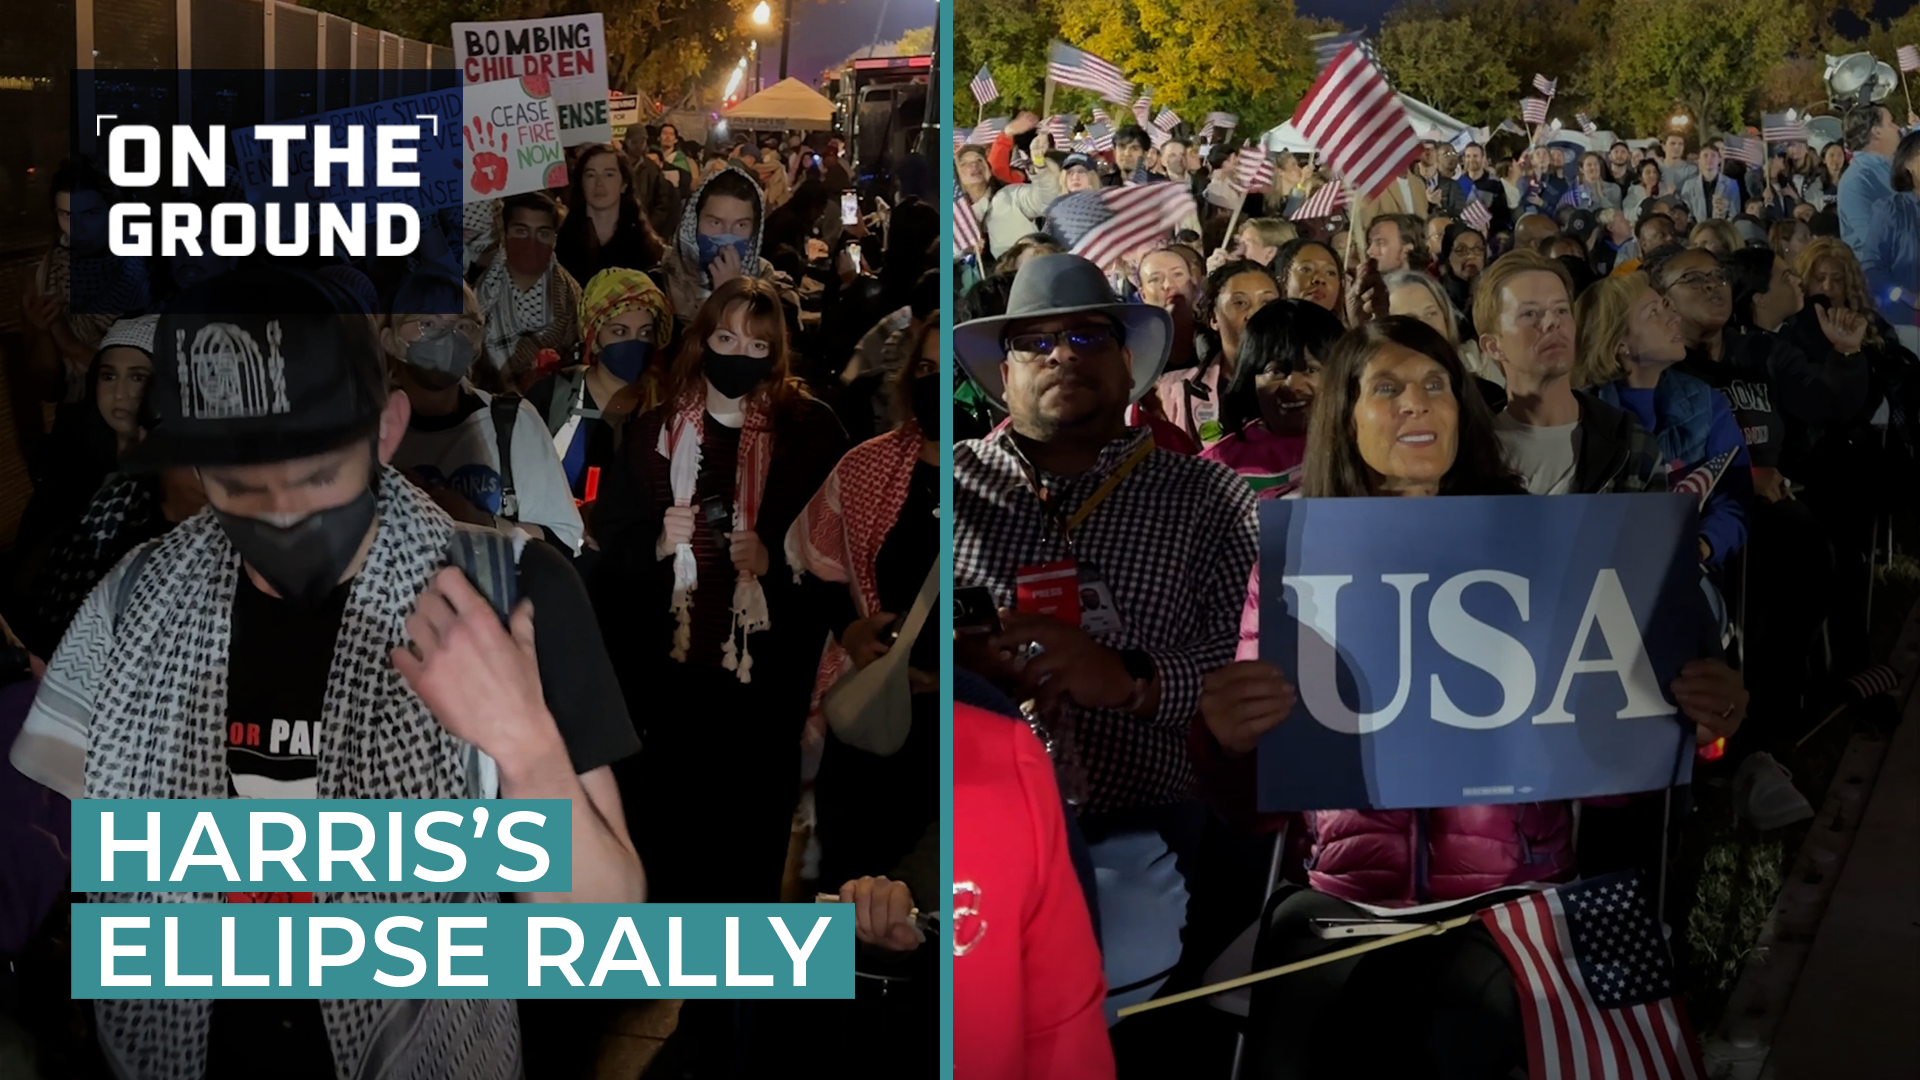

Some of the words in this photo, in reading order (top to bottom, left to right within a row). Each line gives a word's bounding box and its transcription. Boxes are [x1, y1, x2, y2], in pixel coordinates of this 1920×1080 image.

[464, 23, 591, 57] BOMBING
[464, 49, 595, 83] CHILDREN
[392, 93, 462, 128] STUPID
[491, 100, 550, 127] CEASE
[517, 121, 556, 145] FIRE
[517, 141, 561, 169] NOW
[452, 474, 498, 497] GIRLS
[1282, 568, 1677, 735] USA
